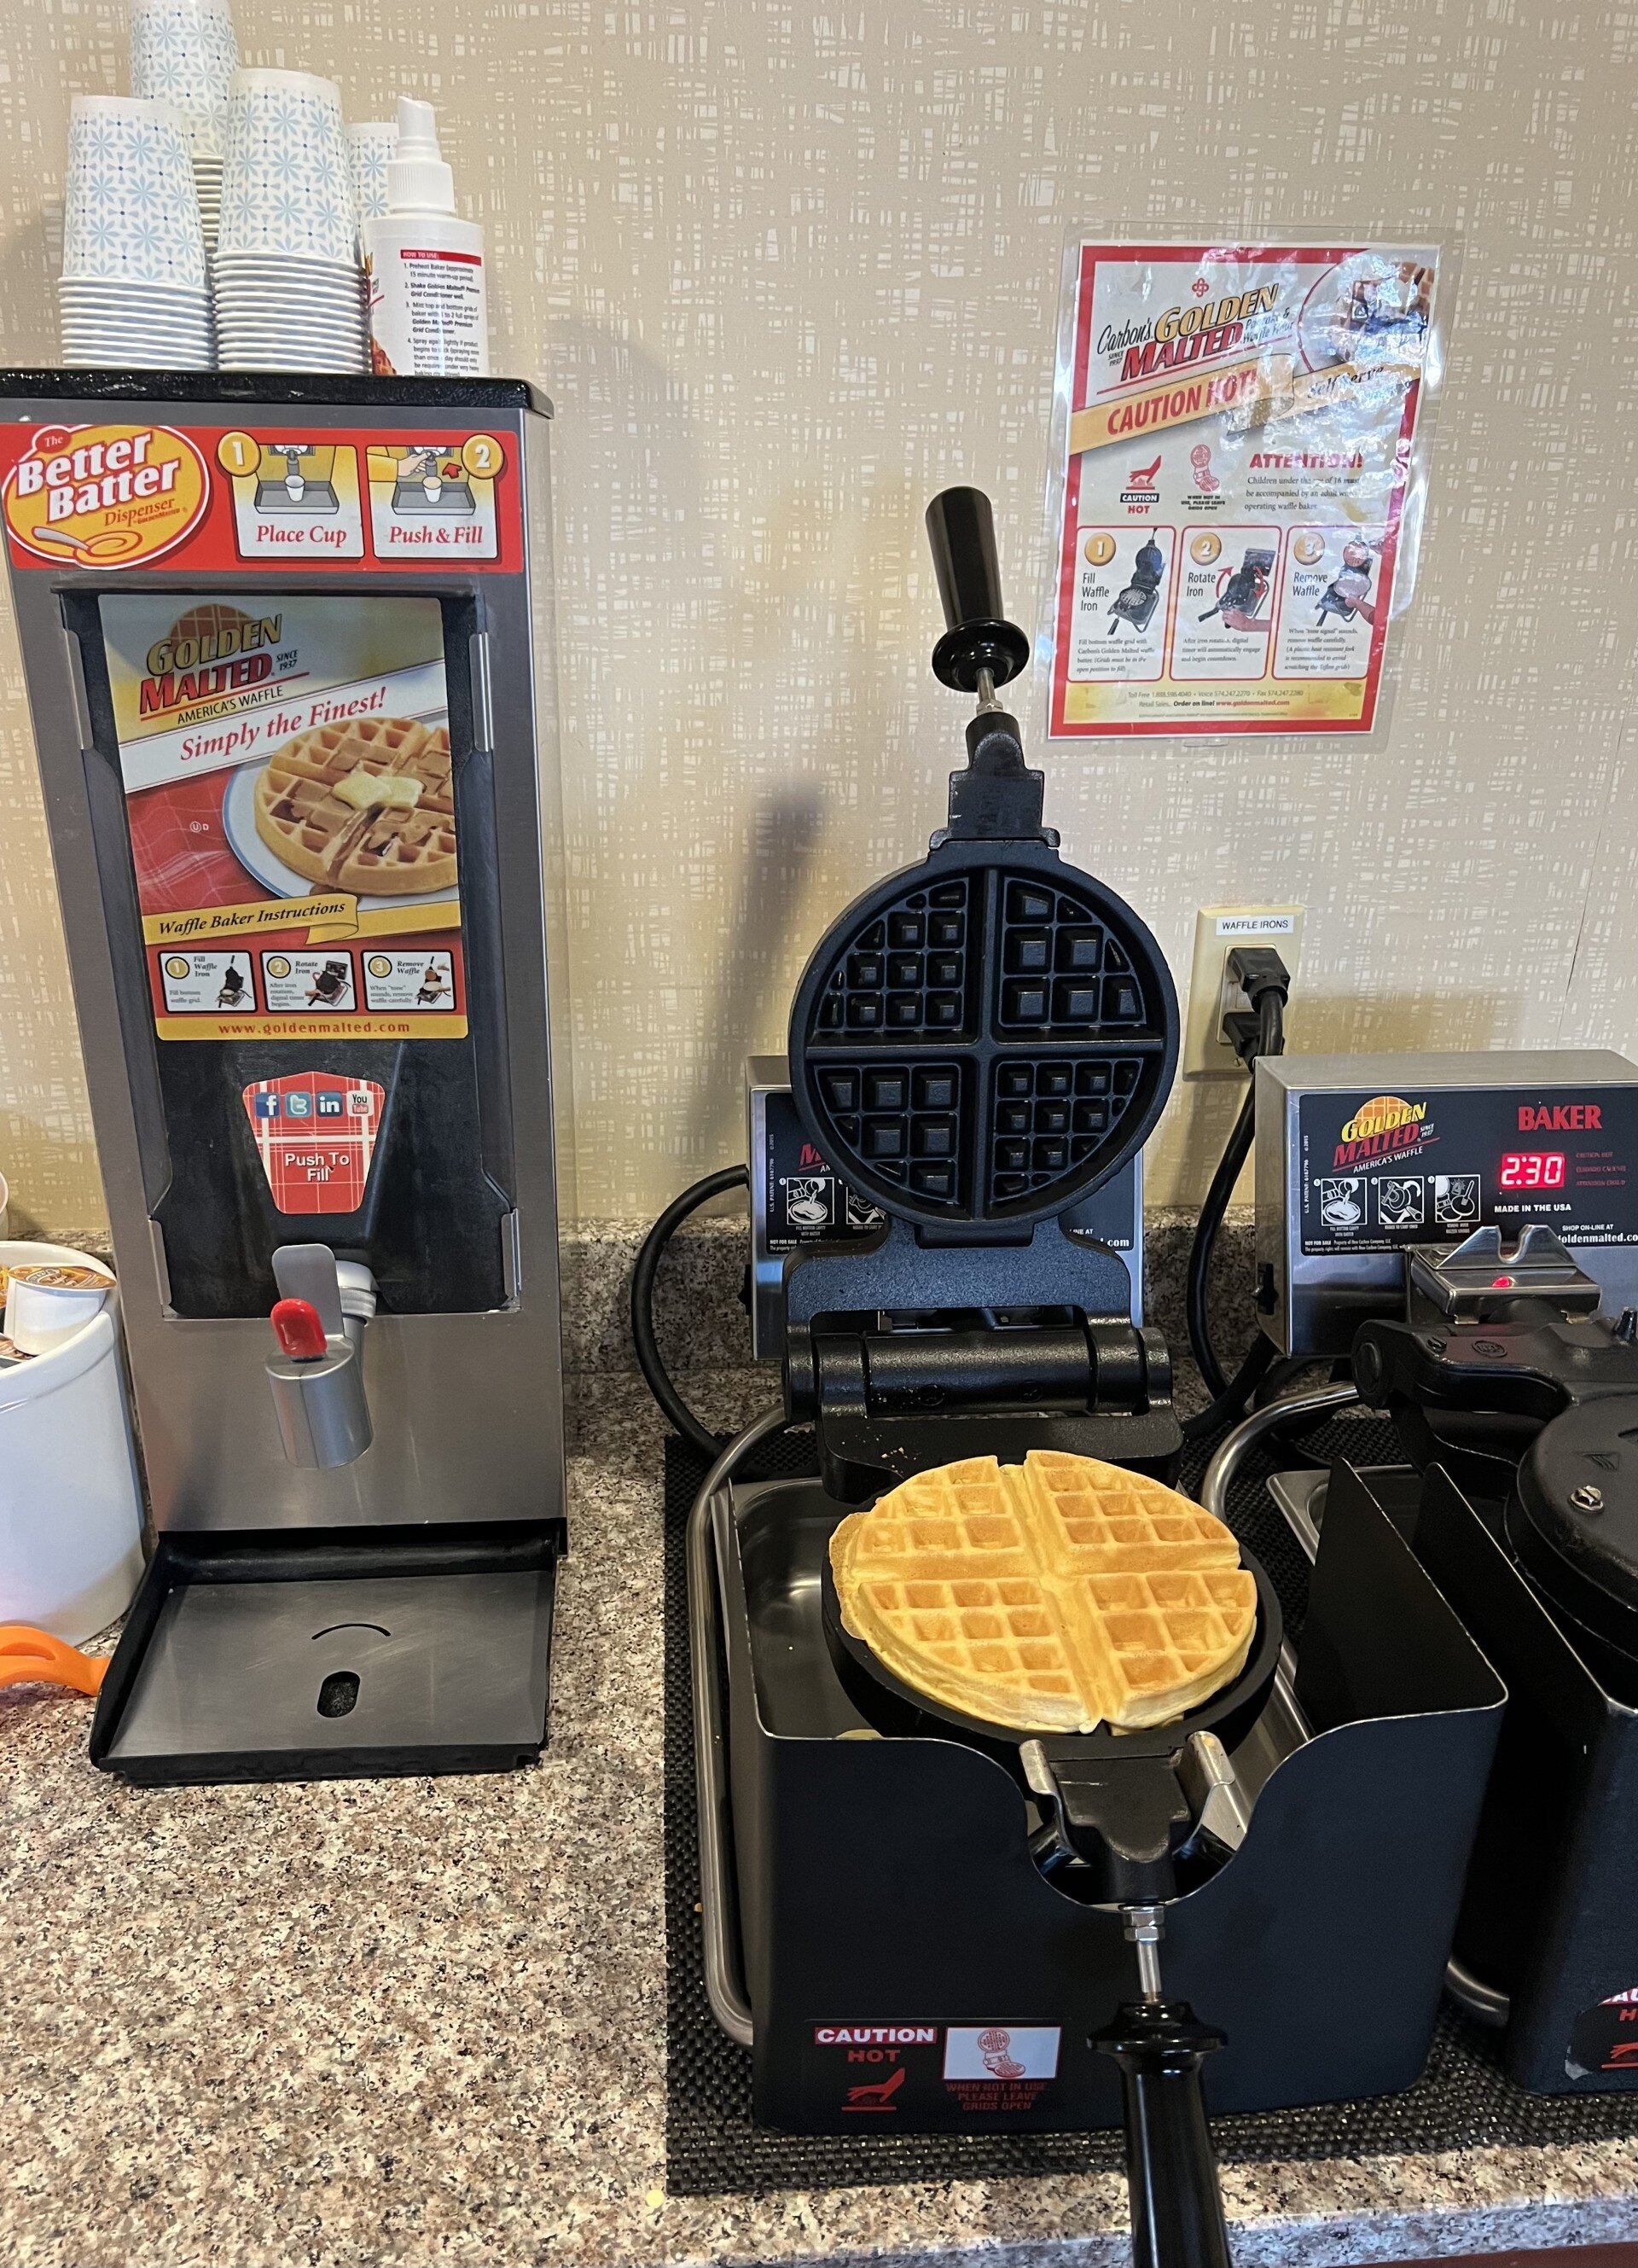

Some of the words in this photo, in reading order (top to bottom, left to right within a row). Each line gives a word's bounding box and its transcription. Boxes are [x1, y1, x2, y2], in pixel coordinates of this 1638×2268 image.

[1097, 317, 1152, 355] Carbon's
[1154, 282, 1280, 344] GOLDEN
[1121, 322, 1244, 382] MALTED
[1107, 384, 1203, 435] CAUTION
[44, 435, 63, 448] The
[229, 440, 246, 467] 1
[474, 442, 491, 468] 2
[1249, 452, 1363, 468] ATTENTION!
[17, 432, 152, 497] Better
[1247, 476, 1278, 485] Children
[1279, 476, 1298, 485] under
[48, 458, 180, 522] Batter
[1256, 490, 1300, 498] accompanied
[1302, 490, 1309, 498] by
[104, 498, 175, 526] Dispenser
[1128, 505, 1150, 514] HOT
[1244, 502, 1276, 512] operating
[1278, 502, 1297, 510] waffle
[256, 524, 305, 544] Place
[310, 526, 347, 548] Cup
[389, 524, 433, 544] Push
[435, 526, 450, 544] &
[453, 524, 484, 544] Fill
[1097, 541, 1105, 556] 1
[1201, 540, 1211, 556] 2
[1305, 540, 1316, 556] 3
[1083, 573, 1095, 584] Fill
[1188, 573, 1217, 584] Rotate
[1293, 573, 1328, 584] Remove
[1082, 586, 1110, 597] Waffle
[1187, 586, 1204, 597] Iron
[1292, 586, 1320, 597] Waffle
[1081, 601, 1098, 611] Iron
[147, 614, 282, 676] GOLDEN
[279, 660, 298, 672] 1937
[140, 654, 273, 714] MALTED
[276, 649, 299, 663] SINCE
[177, 698, 237, 724] AMERICA'S
[238, 685, 283, 707] WAFFLE
[180, 722, 260, 761] Simply
[266, 711, 302, 737] the
[308, 686, 387, 728] Finest!
[159, 916, 207, 935] Waffle
[210, 911, 254, 928] Baker
[257, 901, 346, 922] Instructions
[1222, 921, 1258, 930] WAFFLE
[1259, 920, 1288, 929] IRONS
[195, 962, 218, 971] Waffle
[397, 968, 421, 976] Waffle
[218, 1022, 411, 1036] www.goldenmalted.com
[351, 1094, 368, 1104] You
[351, 1104, 369, 1114] Tube
[1341, 1101, 1427, 1143] GOLDEN
[1518, 1104, 1603, 1131] BAKER
[1333, 1123, 1420, 1167] MALTED
[285, 1152, 325, 1167] Push
[328, 1152, 350, 1166] To
[1353, 1155, 1393, 1174] AMERICA'S
[1393, 1145, 1424, 1161] WAFFLE
[307, 1167, 330, 1182] Fill
[1495, 1205, 1520, 1213] MADE
[1553, 1203, 1571, 1212] USA
[816, 2027, 935, 2043] CAUTION
[847, 2050, 901, 2063] HOT
[946, 2082, 979, 2092] WHEN
[983, 2083, 1006, 2091] NOT
[1009, 2083, 1022, 2091] IN
[1025, 2082, 1046, 2091] USE
[957, 2092, 1000, 2101] PLEASE
[1003, 2092, 1037, 2101] LEAVE
[962, 2102, 998, 2111] GRIDS
[1002, 2102, 1032, 2110] OPEN
